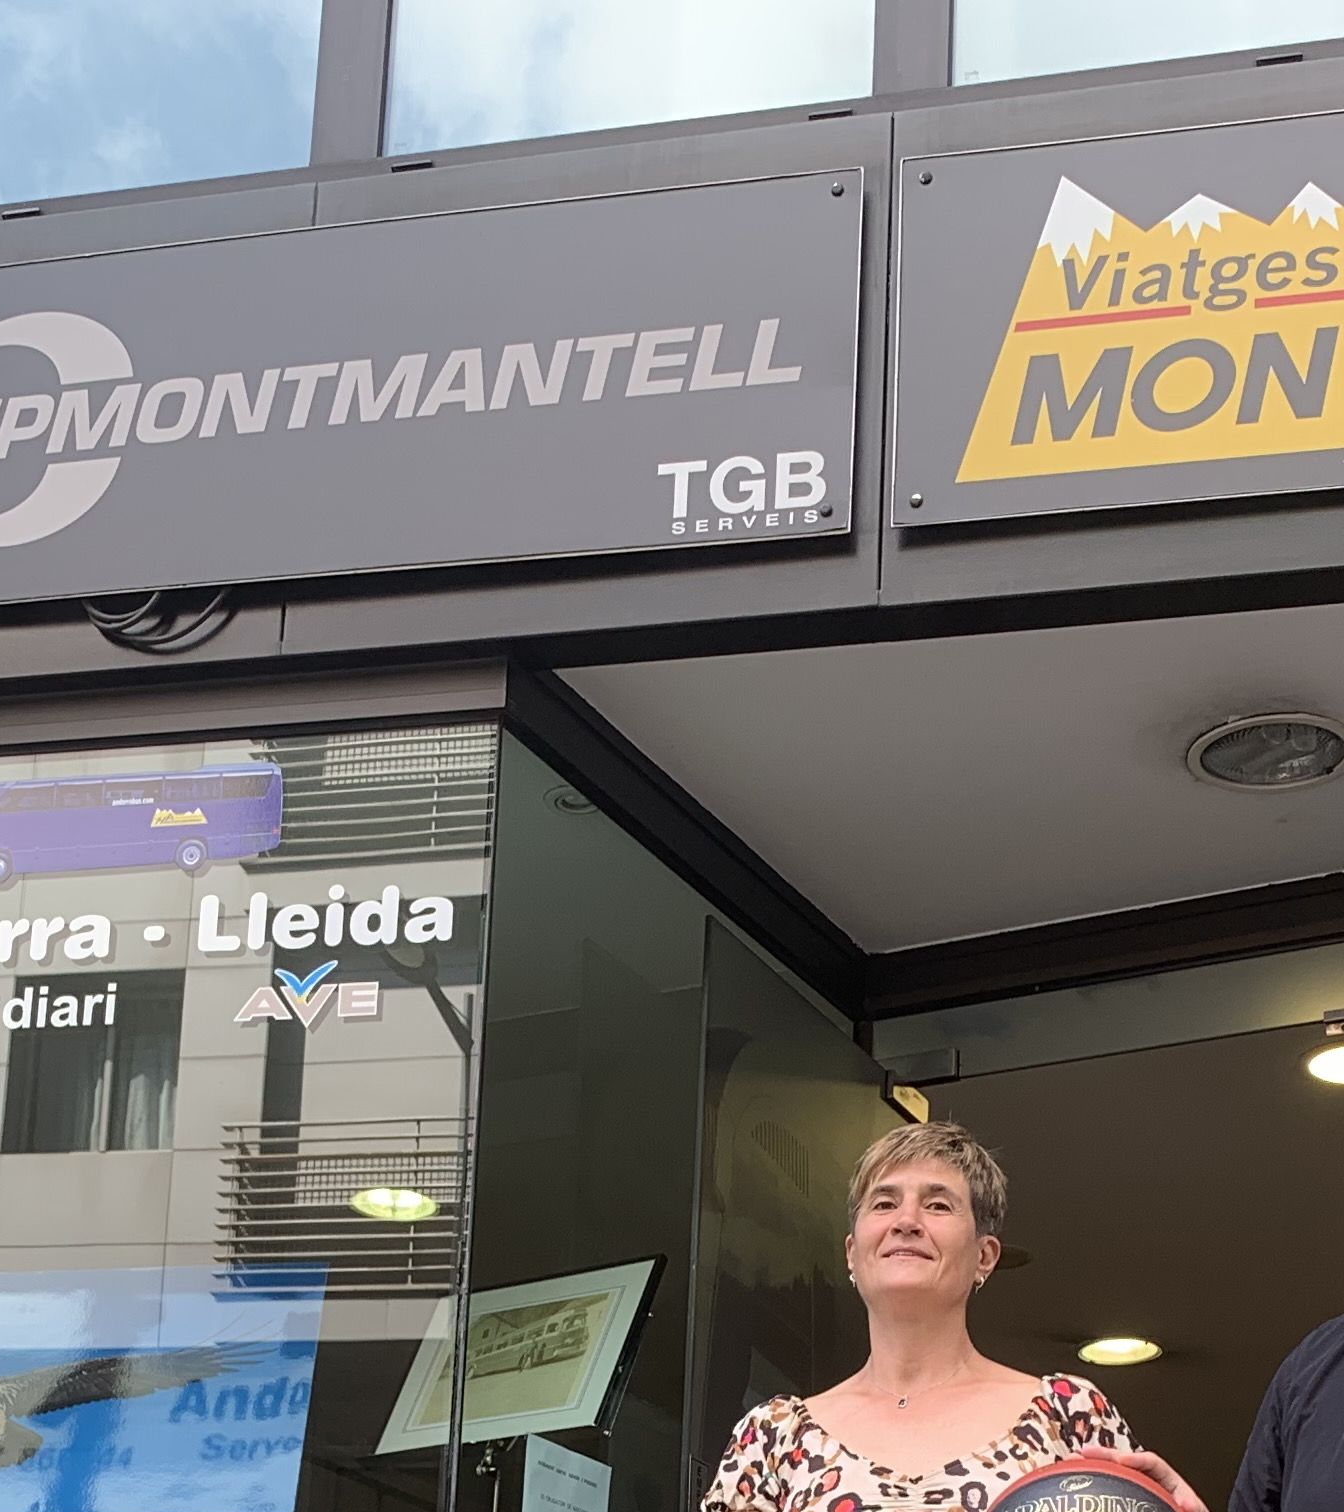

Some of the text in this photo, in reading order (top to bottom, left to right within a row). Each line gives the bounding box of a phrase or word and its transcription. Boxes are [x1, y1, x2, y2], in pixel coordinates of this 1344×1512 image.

[1059, 243, 1341, 314] Viatges
[656, 450, 828, 517] TGB
[670, 507, 820, 536] SERVEIS
[196, 883, 455, 953] Lleida
[3, 982, 118, 1031] diari
[233, 979, 380, 1030] AVE
